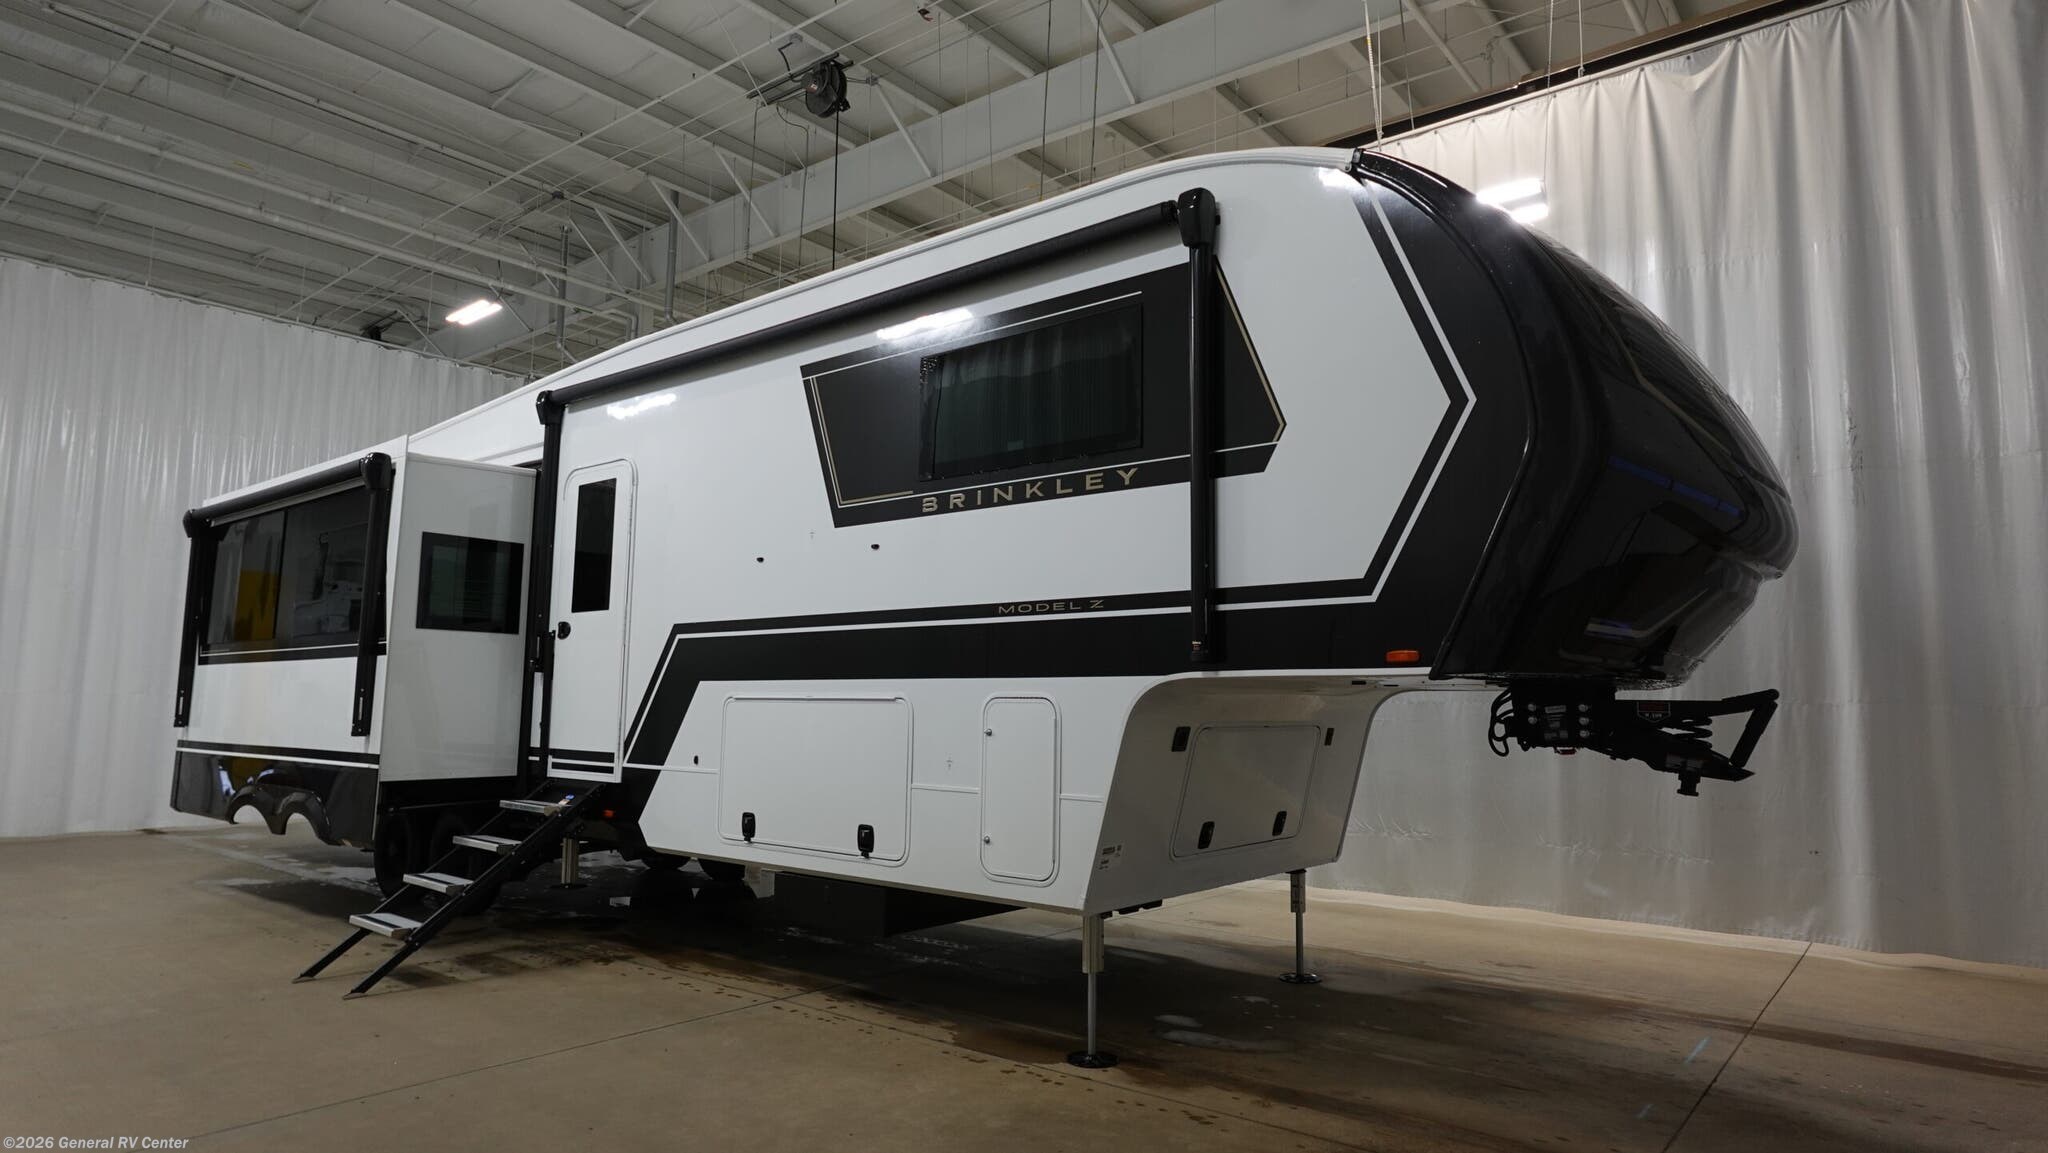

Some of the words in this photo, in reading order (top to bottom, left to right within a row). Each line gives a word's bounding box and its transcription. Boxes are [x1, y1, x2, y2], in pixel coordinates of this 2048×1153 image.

[922, 467, 1138, 513] BRINKLEY
[998, 601, 1081, 615] MODEL
[1089, 600, 1105, 609] Z
